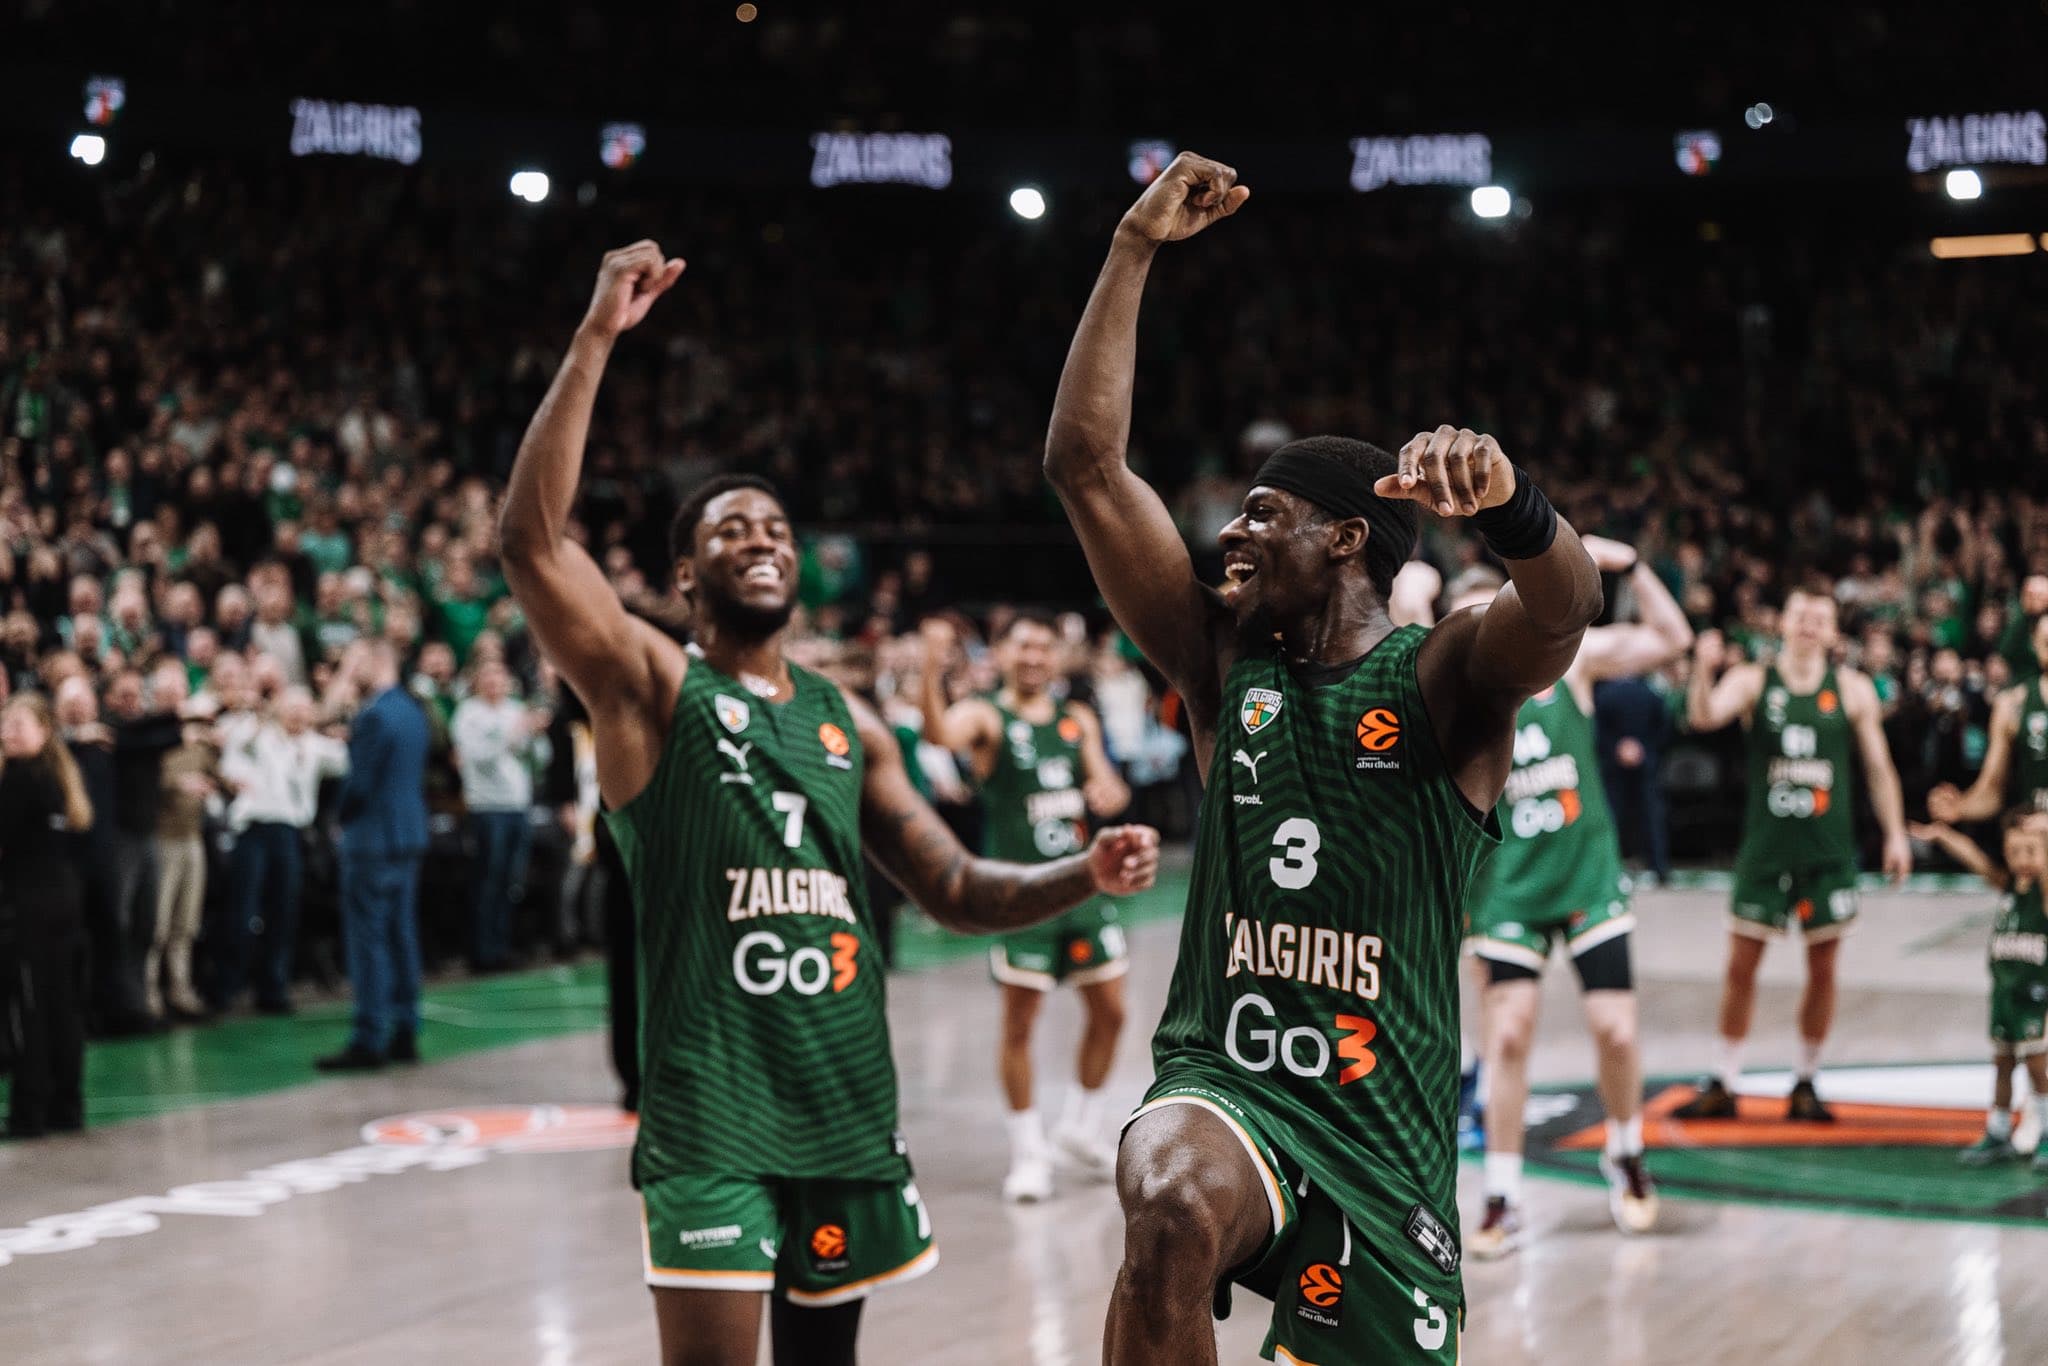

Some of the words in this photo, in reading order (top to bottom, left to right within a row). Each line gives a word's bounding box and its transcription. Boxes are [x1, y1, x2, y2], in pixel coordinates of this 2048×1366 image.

[772, 791, 807, 848] 7
[1269, 817, 1321, 890] 3
[733, 931, 859, 996] Go3
[1225, 993, 1377, 1086] Go3
[1414, 1286, 1448, 1350] 3
